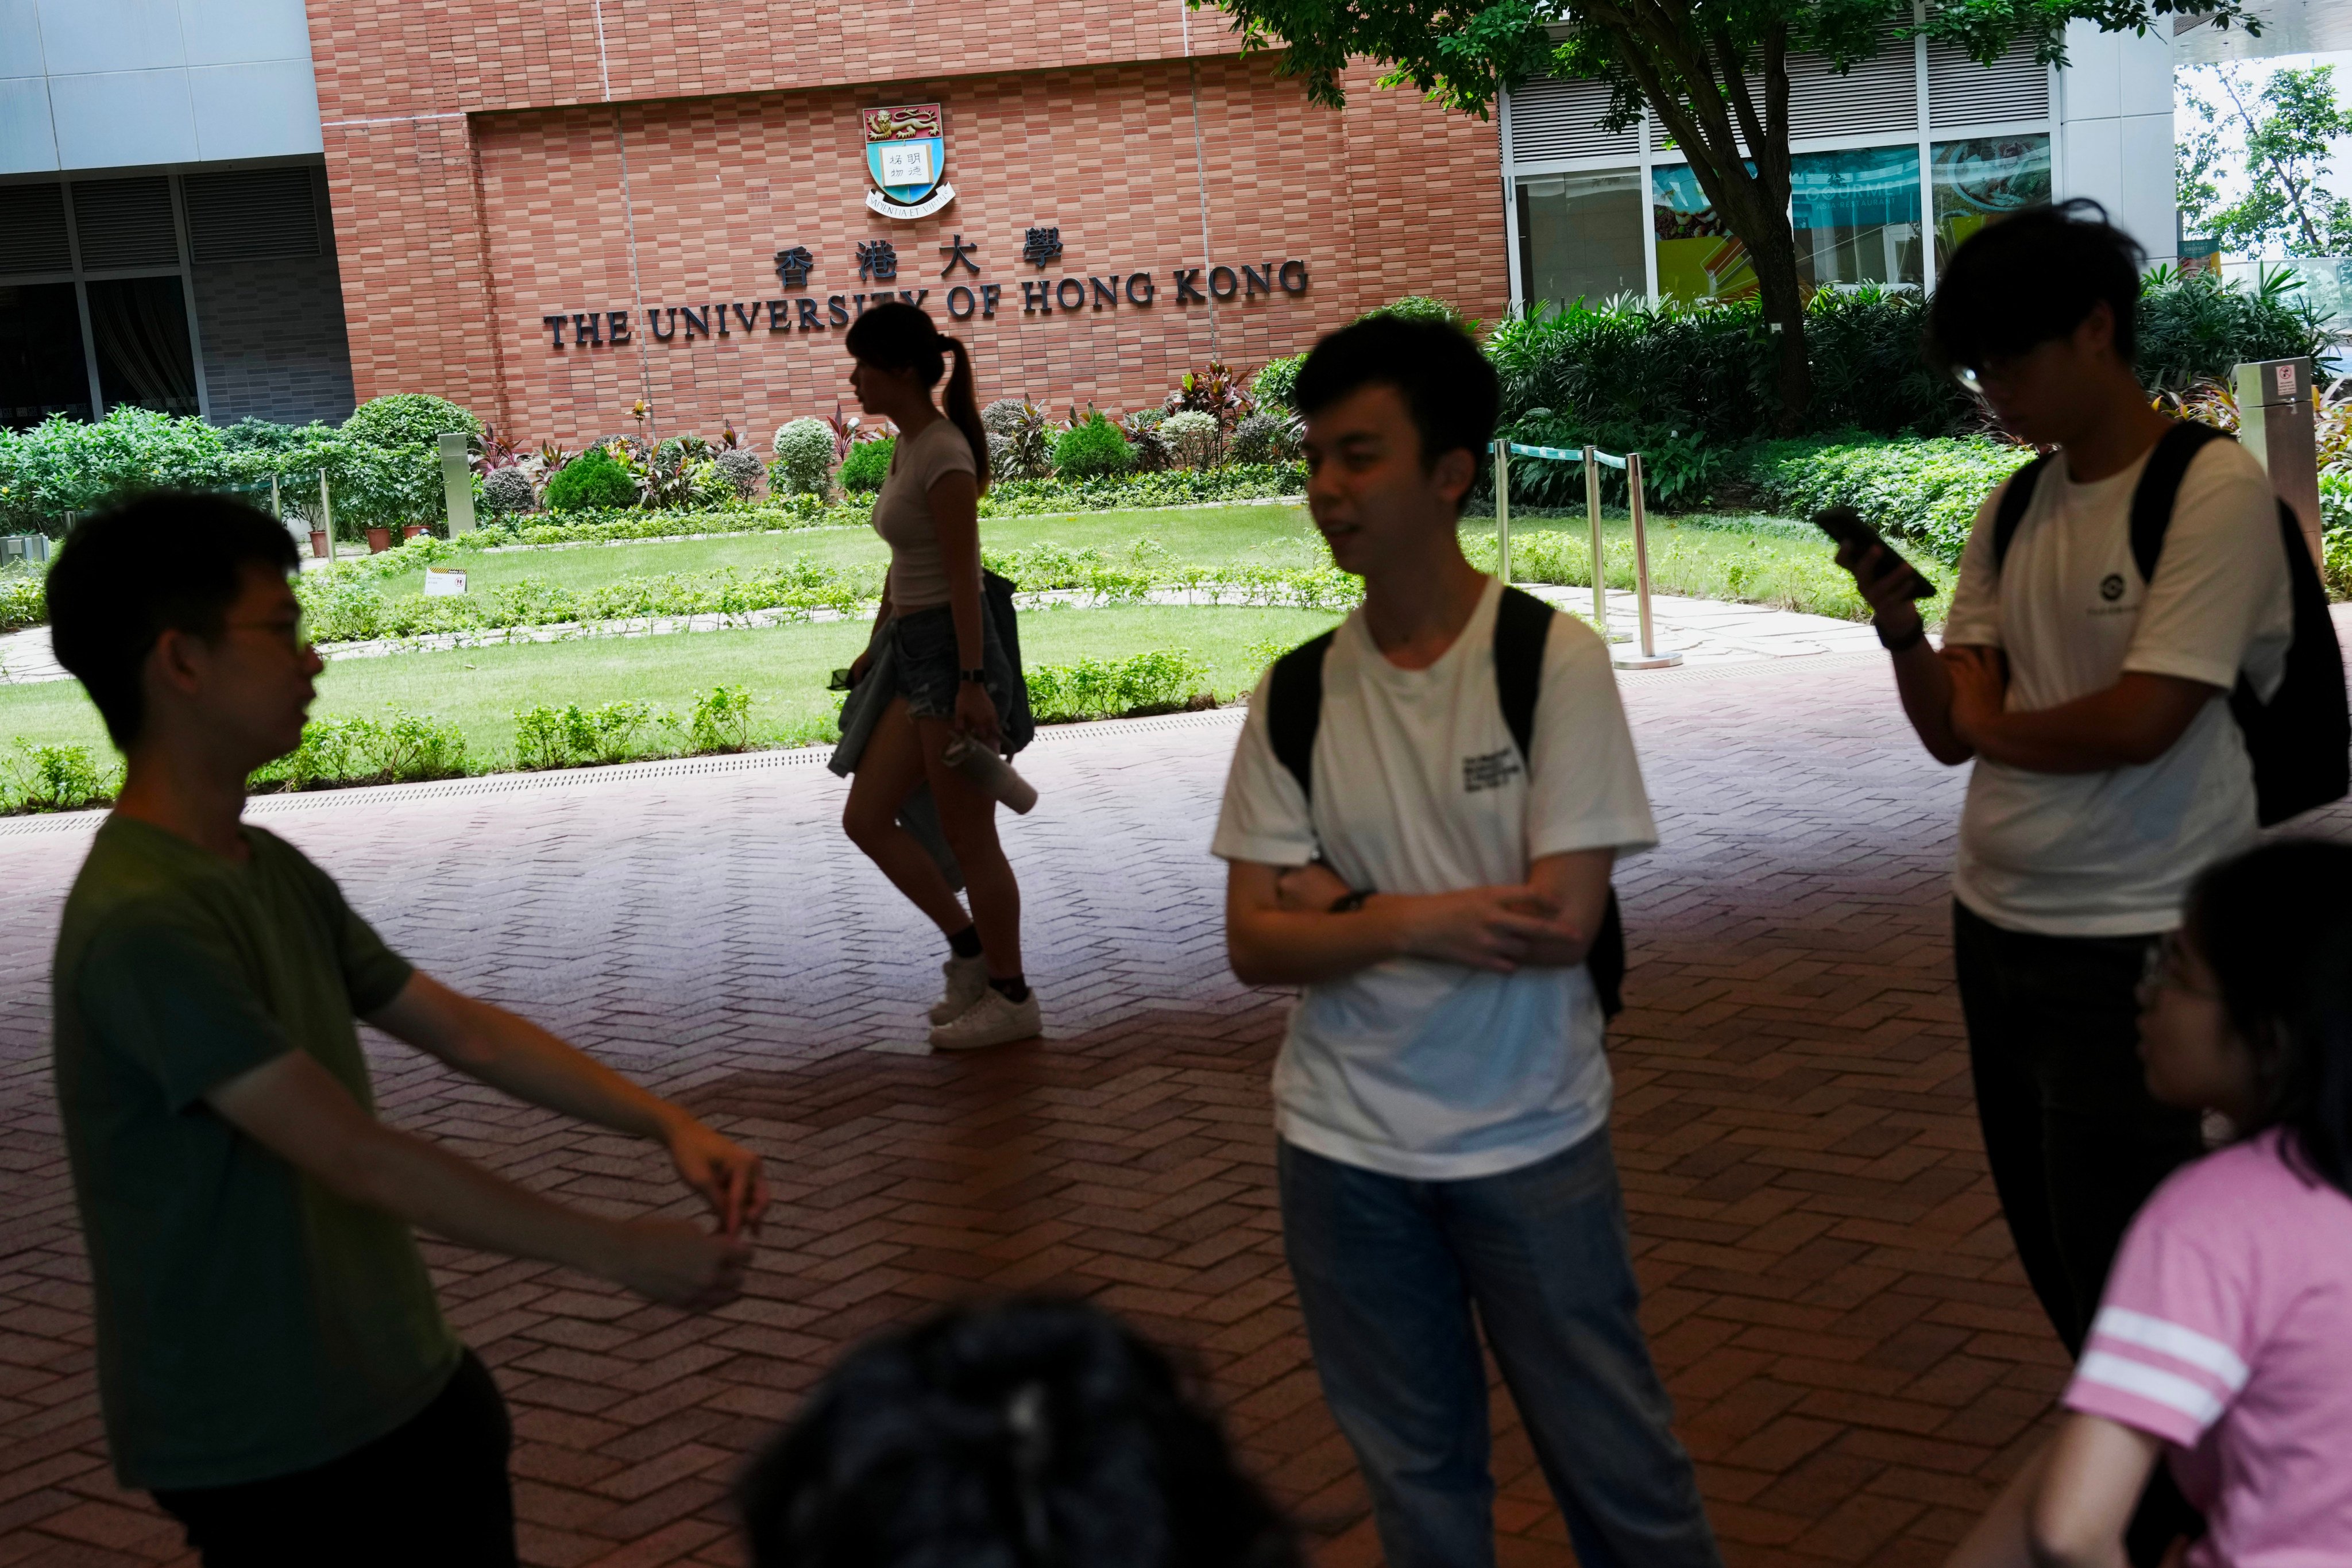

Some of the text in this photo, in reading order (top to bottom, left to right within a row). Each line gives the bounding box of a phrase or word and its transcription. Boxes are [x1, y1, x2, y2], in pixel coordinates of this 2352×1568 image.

[1806, 180, 1906, 200] GOURMET
[870, 196, 907, 217] SAPIENTIA
[910, 207, 919, 217] ET
[1817, 197, 1895, 210] ASIA RESTAURANT
[774, 226, 1064, 287] 香港大學
[544, 311, 632, 345] THE
[947, 283, 1002, 318] OF
[1021, 271, 1155, 312] HONG
[1174, 259, 1308, 302] KONG
